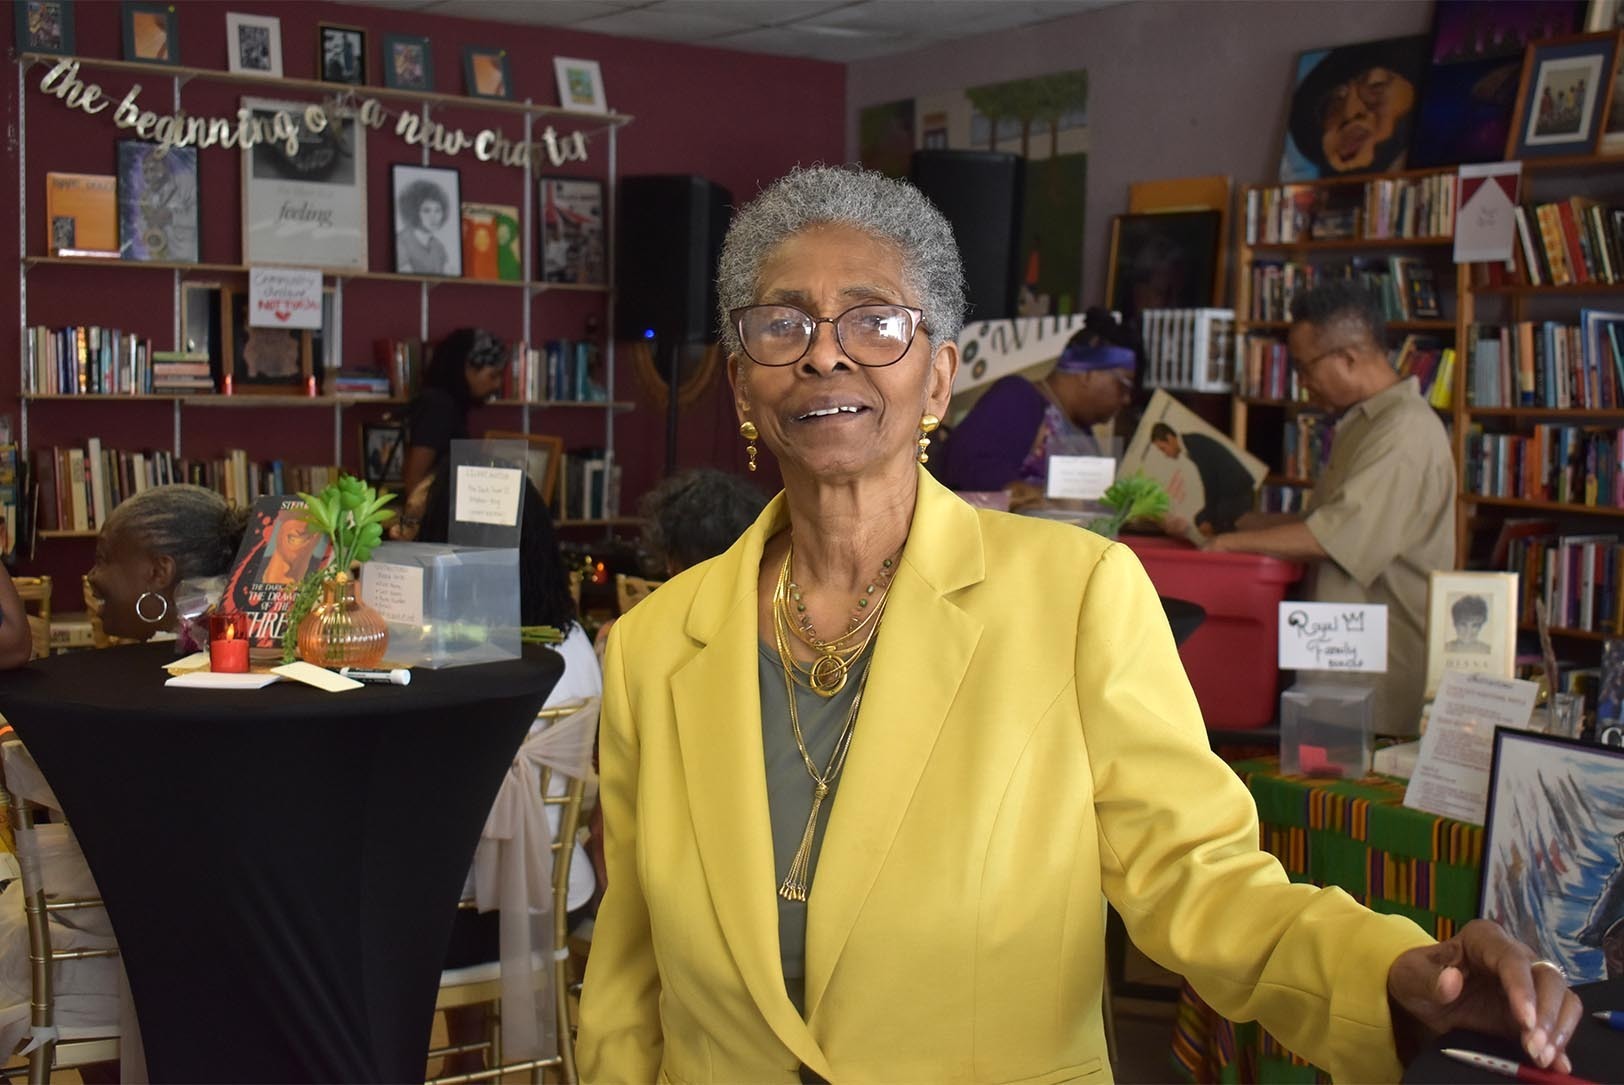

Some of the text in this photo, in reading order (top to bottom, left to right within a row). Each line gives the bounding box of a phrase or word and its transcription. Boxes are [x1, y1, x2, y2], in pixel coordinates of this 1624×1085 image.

[39, 56, 109, 114] the
[113, 84, 299, 158] beginning
[361, 98, 387, 130] a
[395, 109, 472, 156] new
[274, 200, 334, 229] feeling
[248, 591, 267, 601] THE
[261, 601, 273, 610] OF
[246, 611, 289, 638] THRE
[1287, 609, 1339, 638] Royal
[1305, 637, 1358, 664] Family
